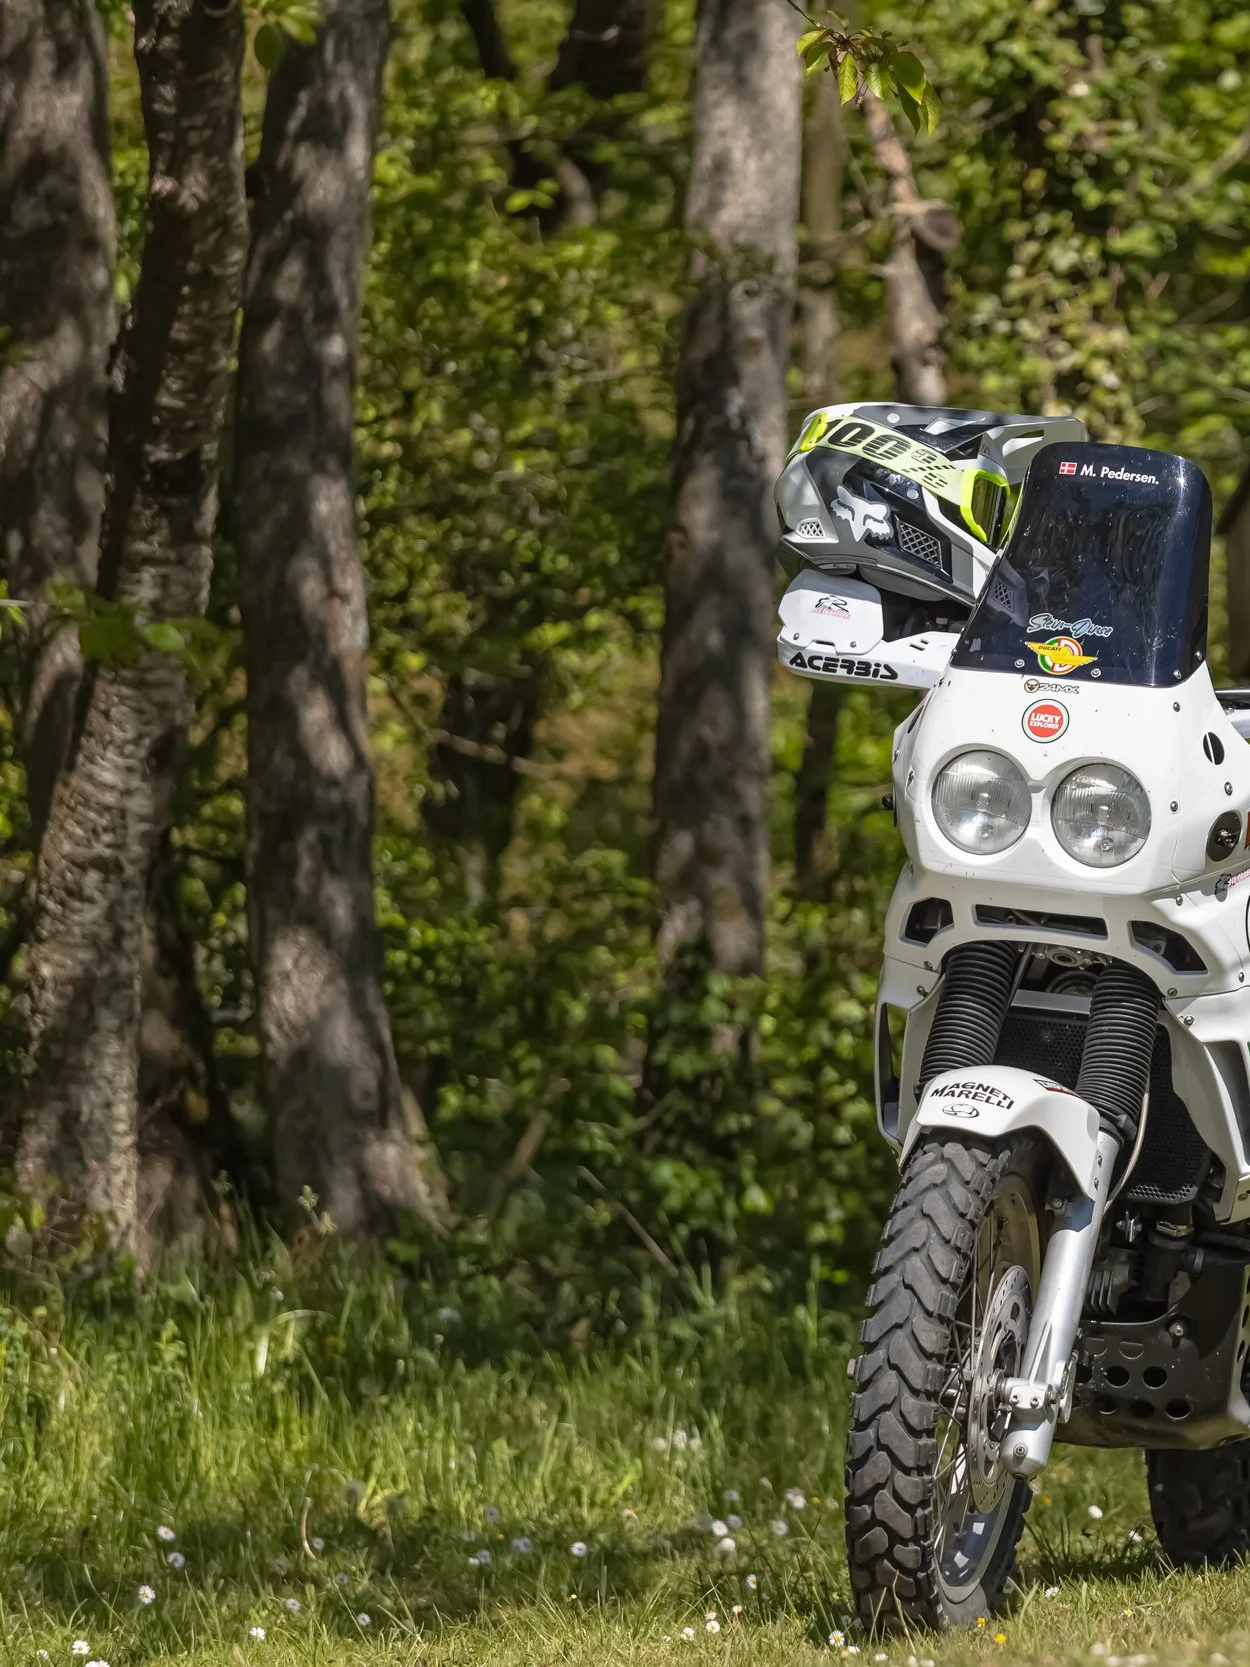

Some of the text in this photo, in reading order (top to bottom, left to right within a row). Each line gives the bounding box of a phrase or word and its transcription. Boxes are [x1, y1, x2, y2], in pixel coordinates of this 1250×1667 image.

[1080, 463, 1160, 485] M. Pedersen.
[789, 651, 898, 680] ACERBIS
[1029, 720, 1059, 730] EXPLORER
[1030, 712, 1061, 724] LUCKY
[930, 1084, 1015, 1110] MARELLI
